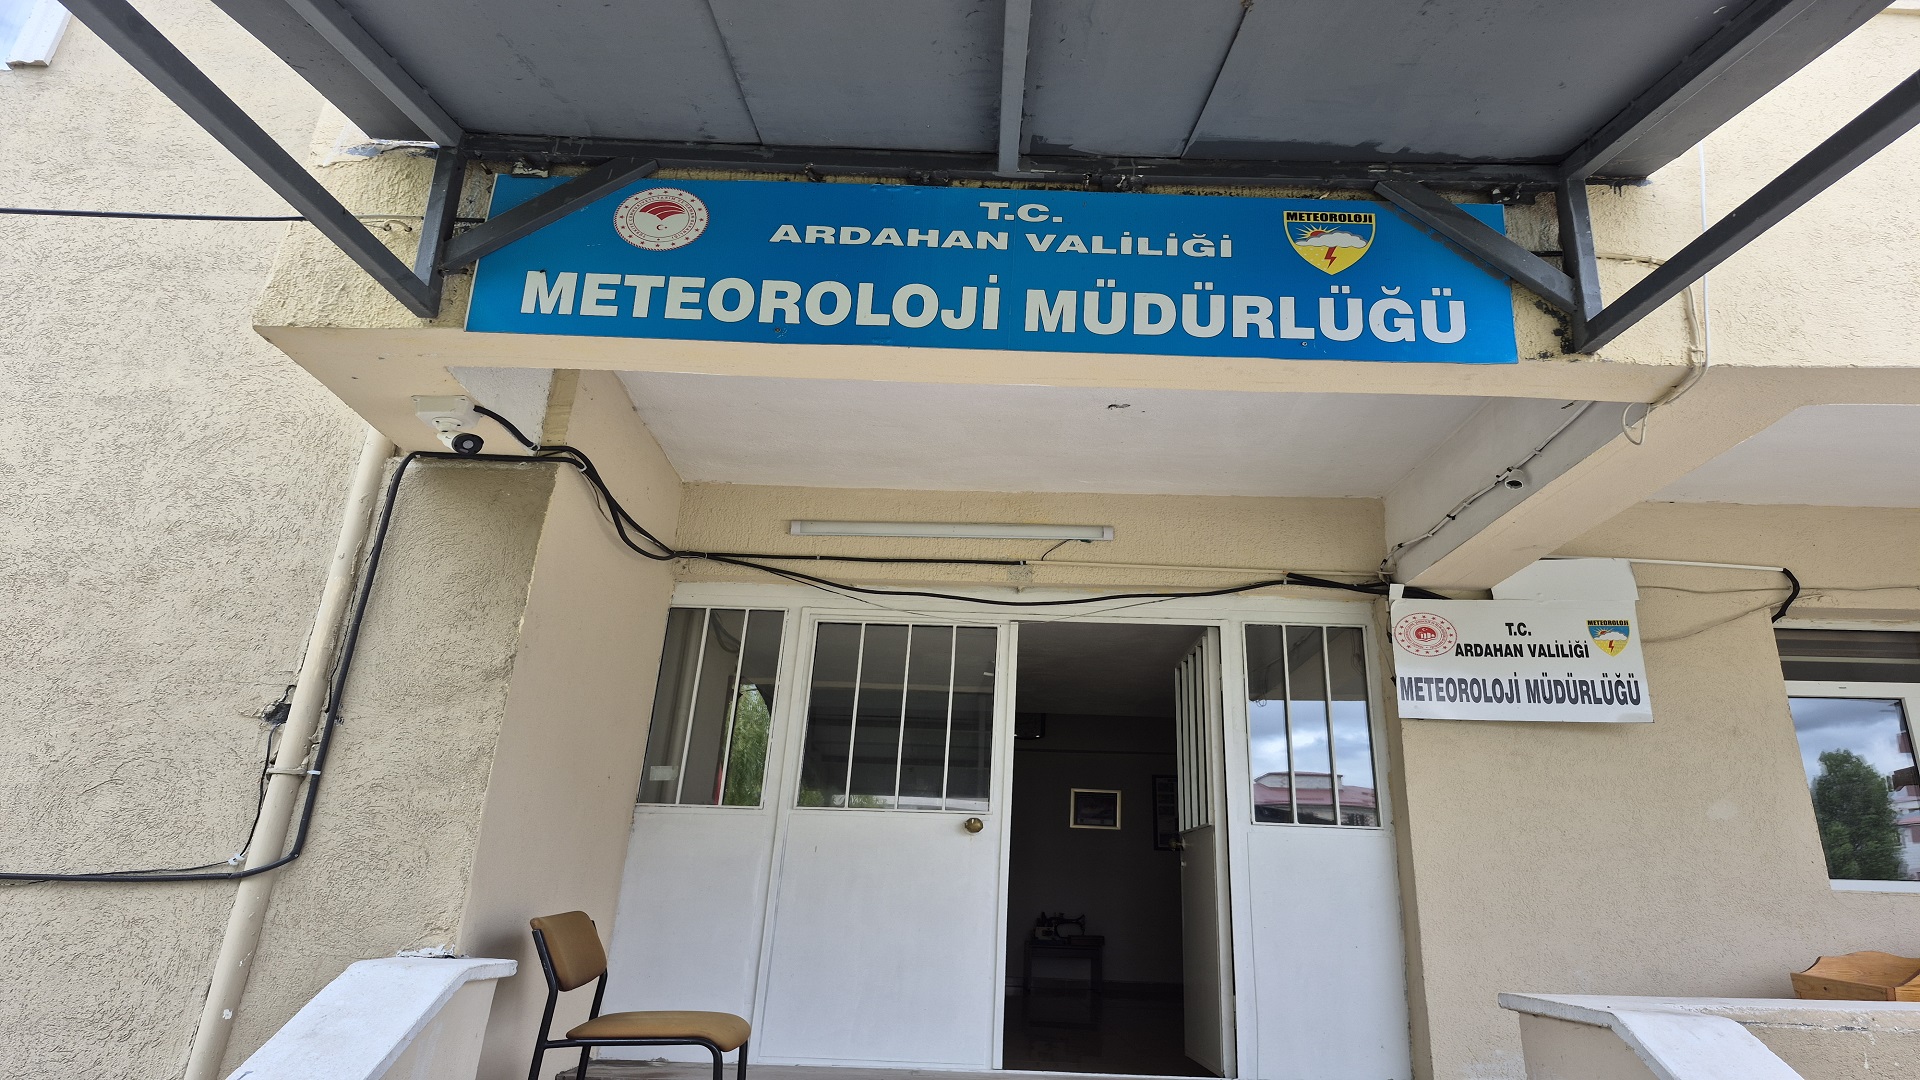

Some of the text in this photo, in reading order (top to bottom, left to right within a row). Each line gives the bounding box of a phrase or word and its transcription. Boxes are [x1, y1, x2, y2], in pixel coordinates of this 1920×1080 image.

[980, 202, 1063, 223] T.C.
[769, 224, 1233, 259] ARDAHAN VALİLİĞİ
[520, 271, 1467, 344] METEOROLOJİ MÜDÜRLÜĞÜ
[1505, 622, 1532, 637] T.C.
[1455, 640, 1590, 659] ARDAHAN VALİLİĞİ
[1399, 671, 1641, 706] METEOROLOJİ MÜDÜRLÜĞÜ
